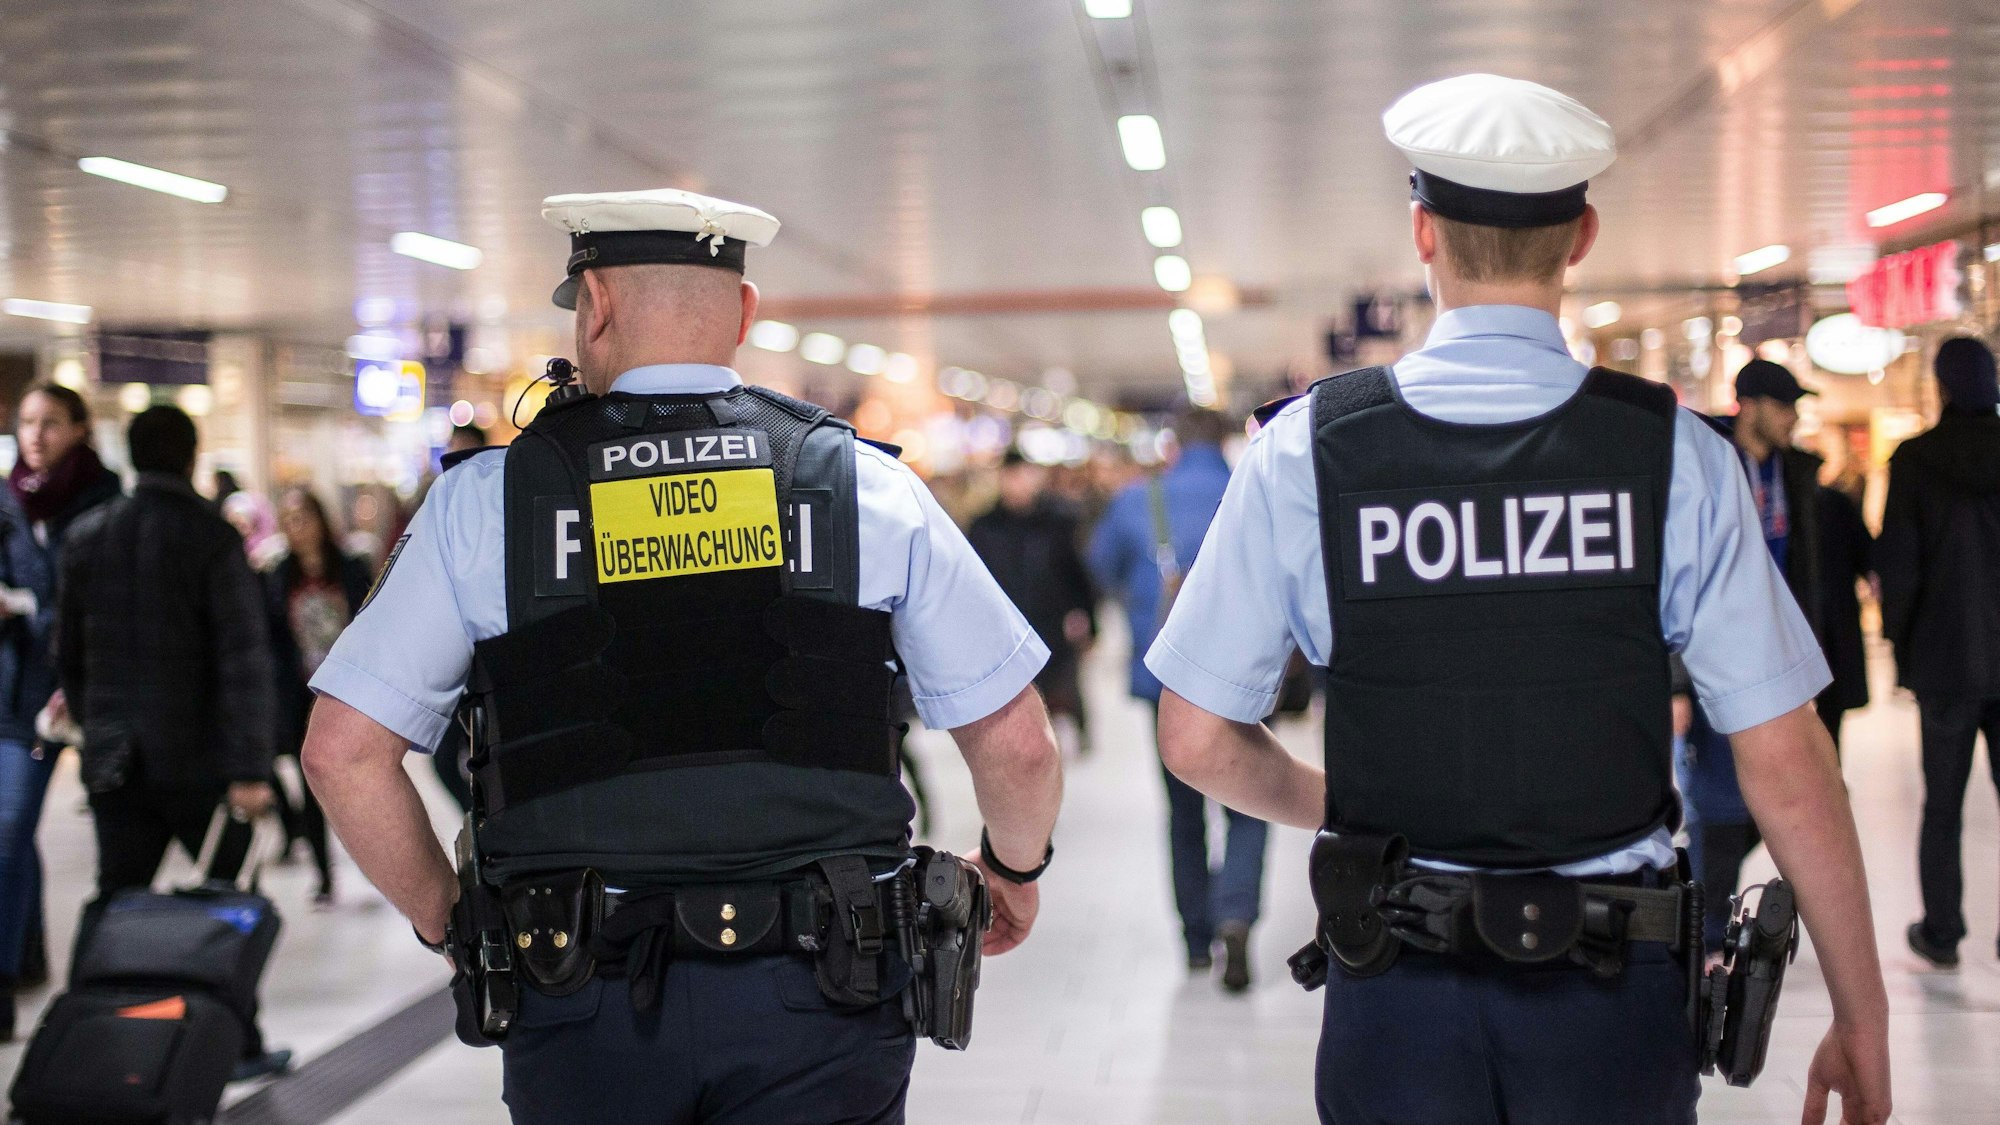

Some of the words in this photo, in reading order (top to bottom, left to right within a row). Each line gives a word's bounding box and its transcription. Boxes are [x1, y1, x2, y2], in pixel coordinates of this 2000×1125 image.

[603, 435, 758, 472] POLIZEI
[649, 478, 718, 517] VIDEO
[600, 525, 777, 577] ÜBERWACHUNG
[1359, 493, 1634, 583] POLIZEI
